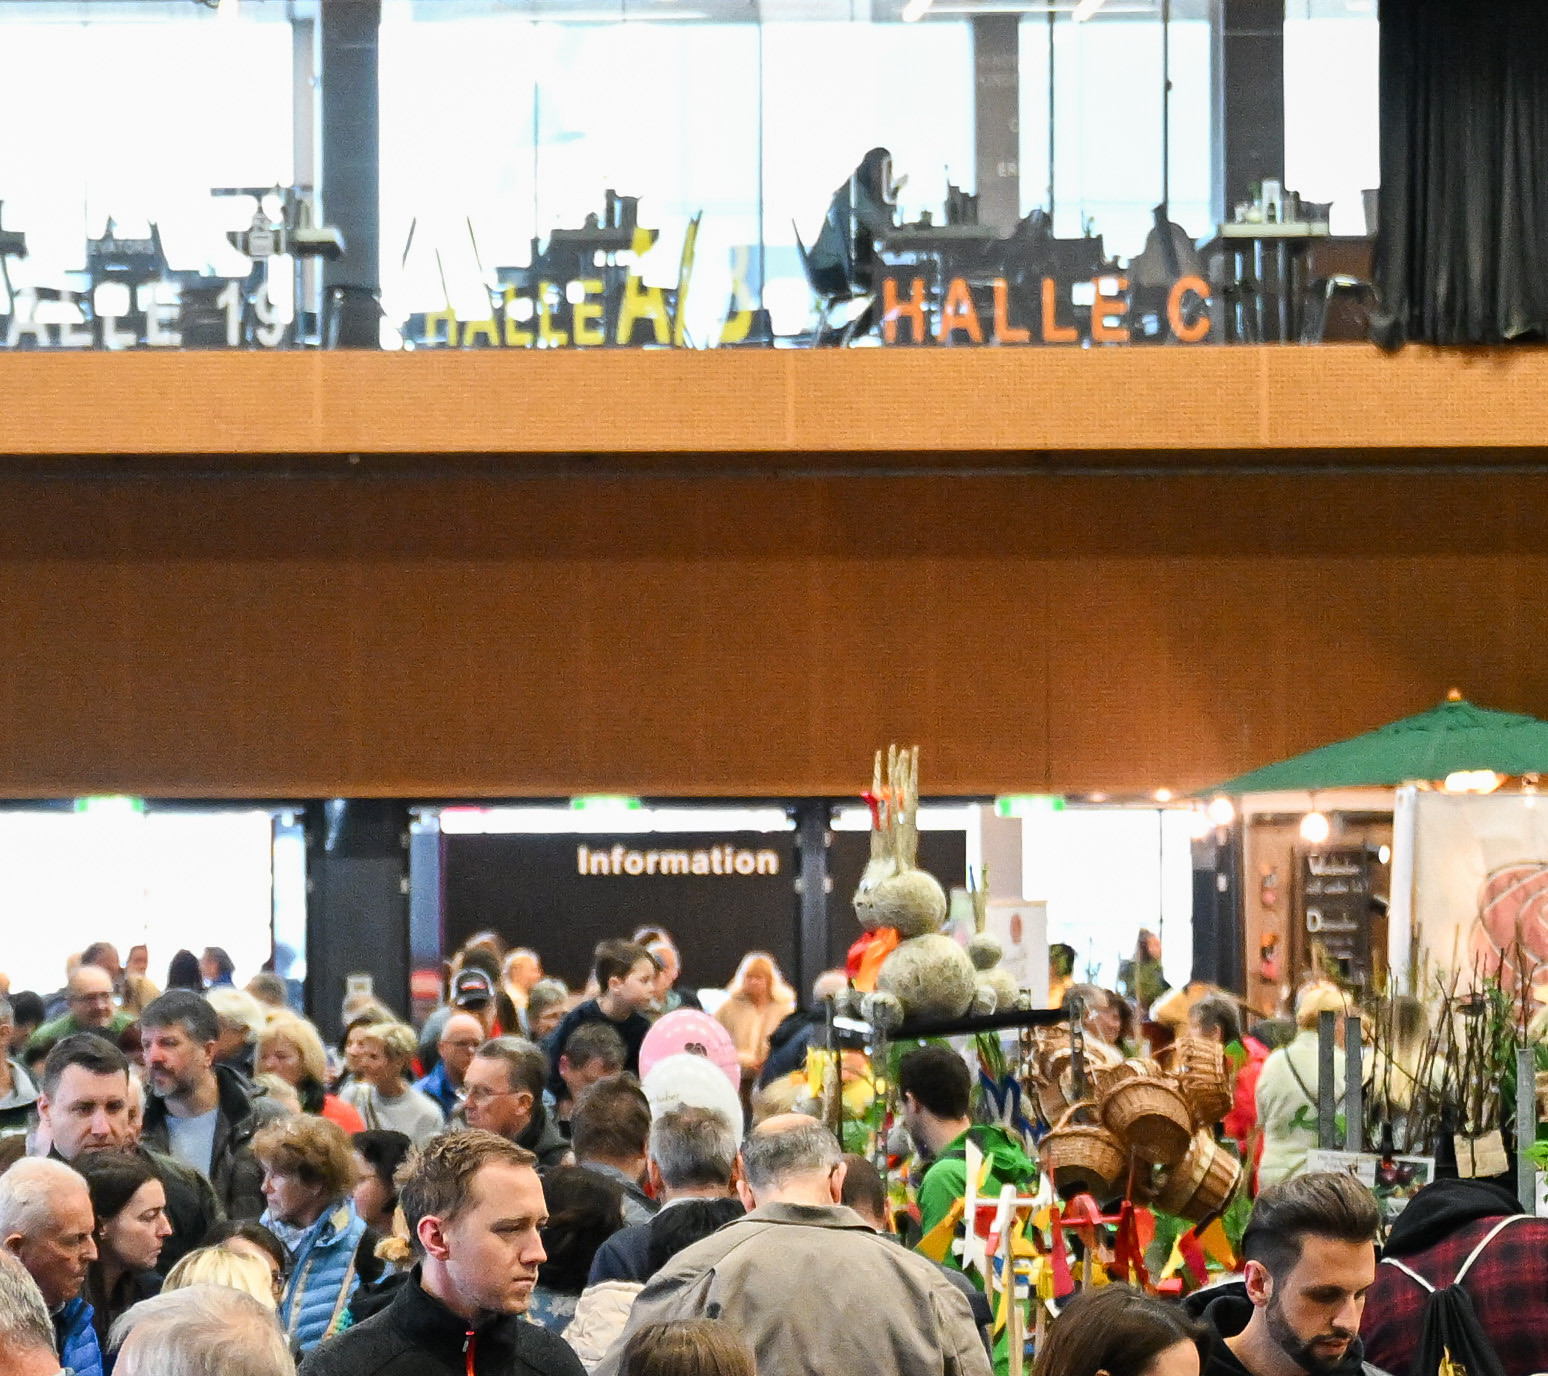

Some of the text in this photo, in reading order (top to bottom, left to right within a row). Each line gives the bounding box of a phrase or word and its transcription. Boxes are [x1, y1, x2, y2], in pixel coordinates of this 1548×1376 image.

[213, 282, 288, 348] 19
[425, 276, 605, 346] HALLE
[883, 274, 1212, 346] HALLE C
[577, 846, 779, 876] Information
